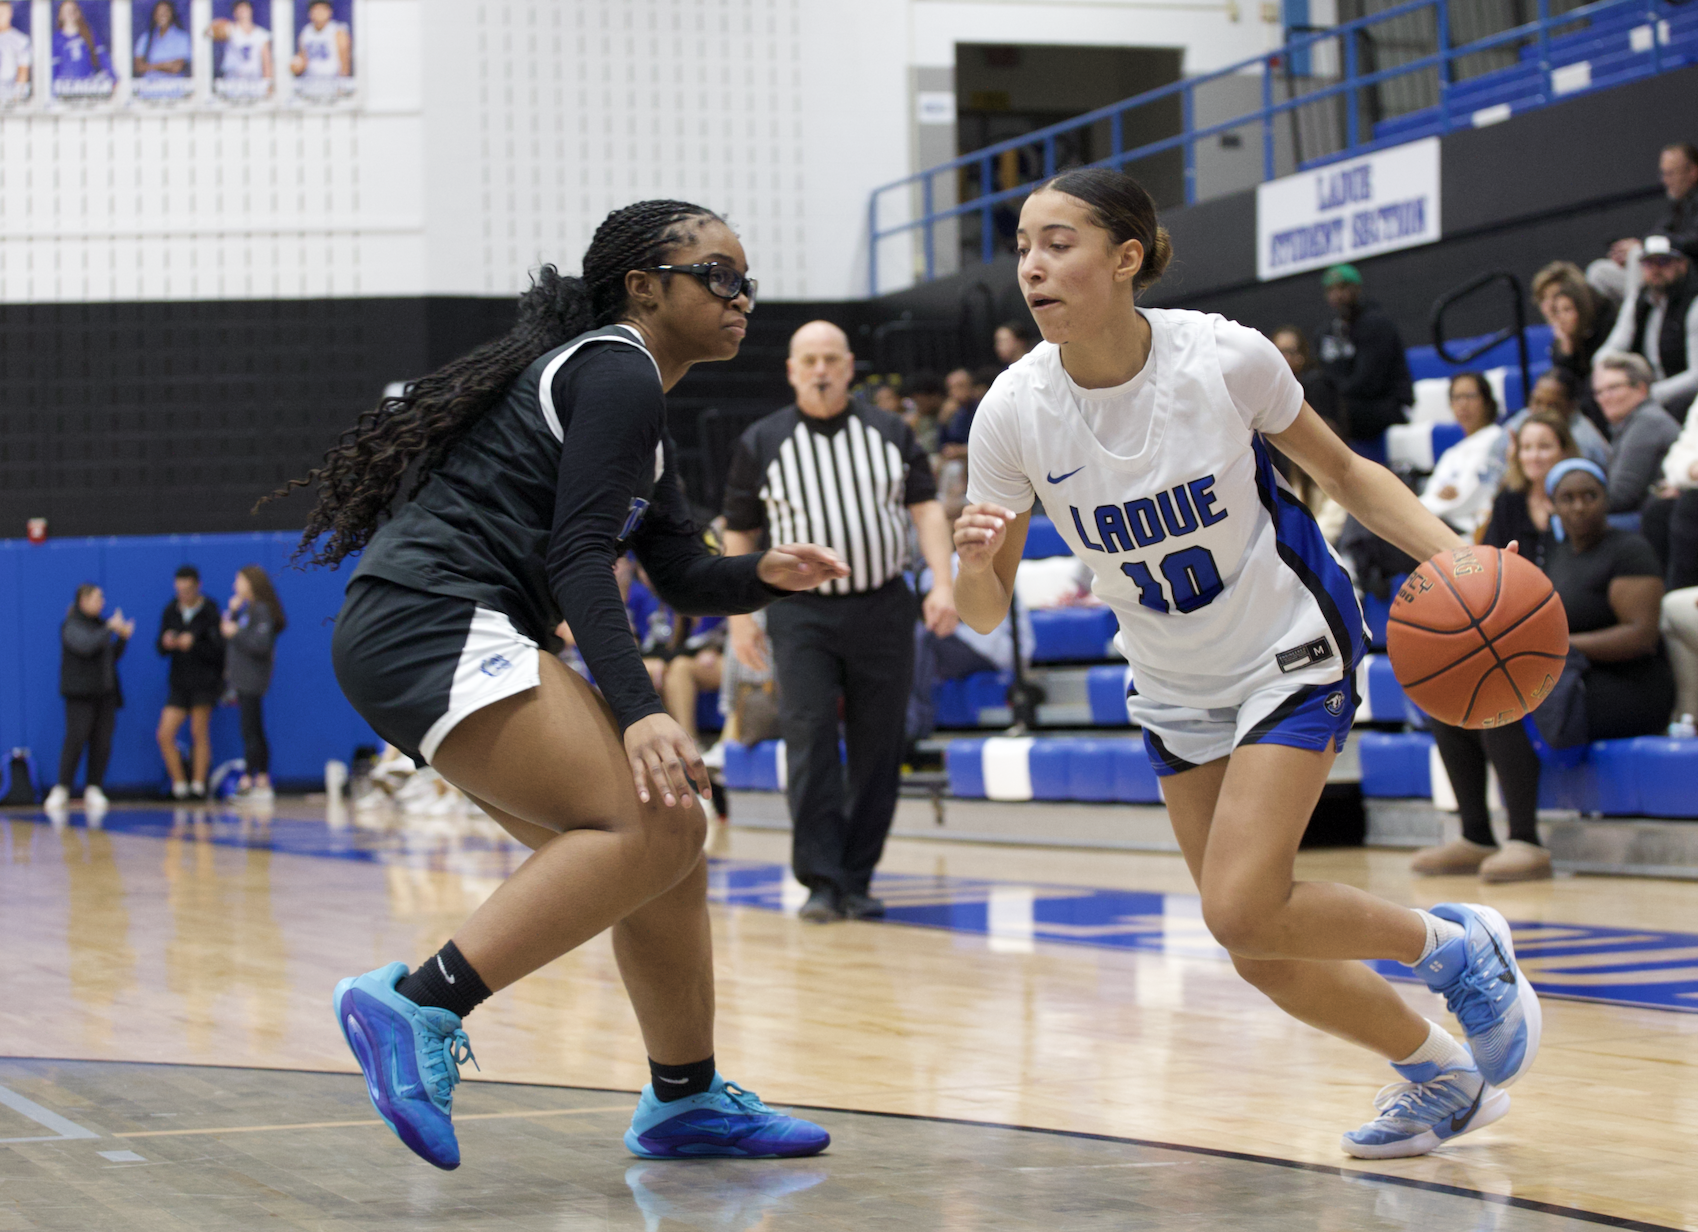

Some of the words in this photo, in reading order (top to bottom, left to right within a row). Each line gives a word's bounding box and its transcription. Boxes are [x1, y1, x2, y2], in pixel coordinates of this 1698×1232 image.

[1318, 165, 1370, 210] LADUE
[1271, 217, 1343, 266] STUDENT
[1352, 197, 1426, 247] SECTION
[1069, 474, 1229, 554] LADUE
[1120, 545, 1225, 614] 10
[1313, 645, 1325, 657] M
